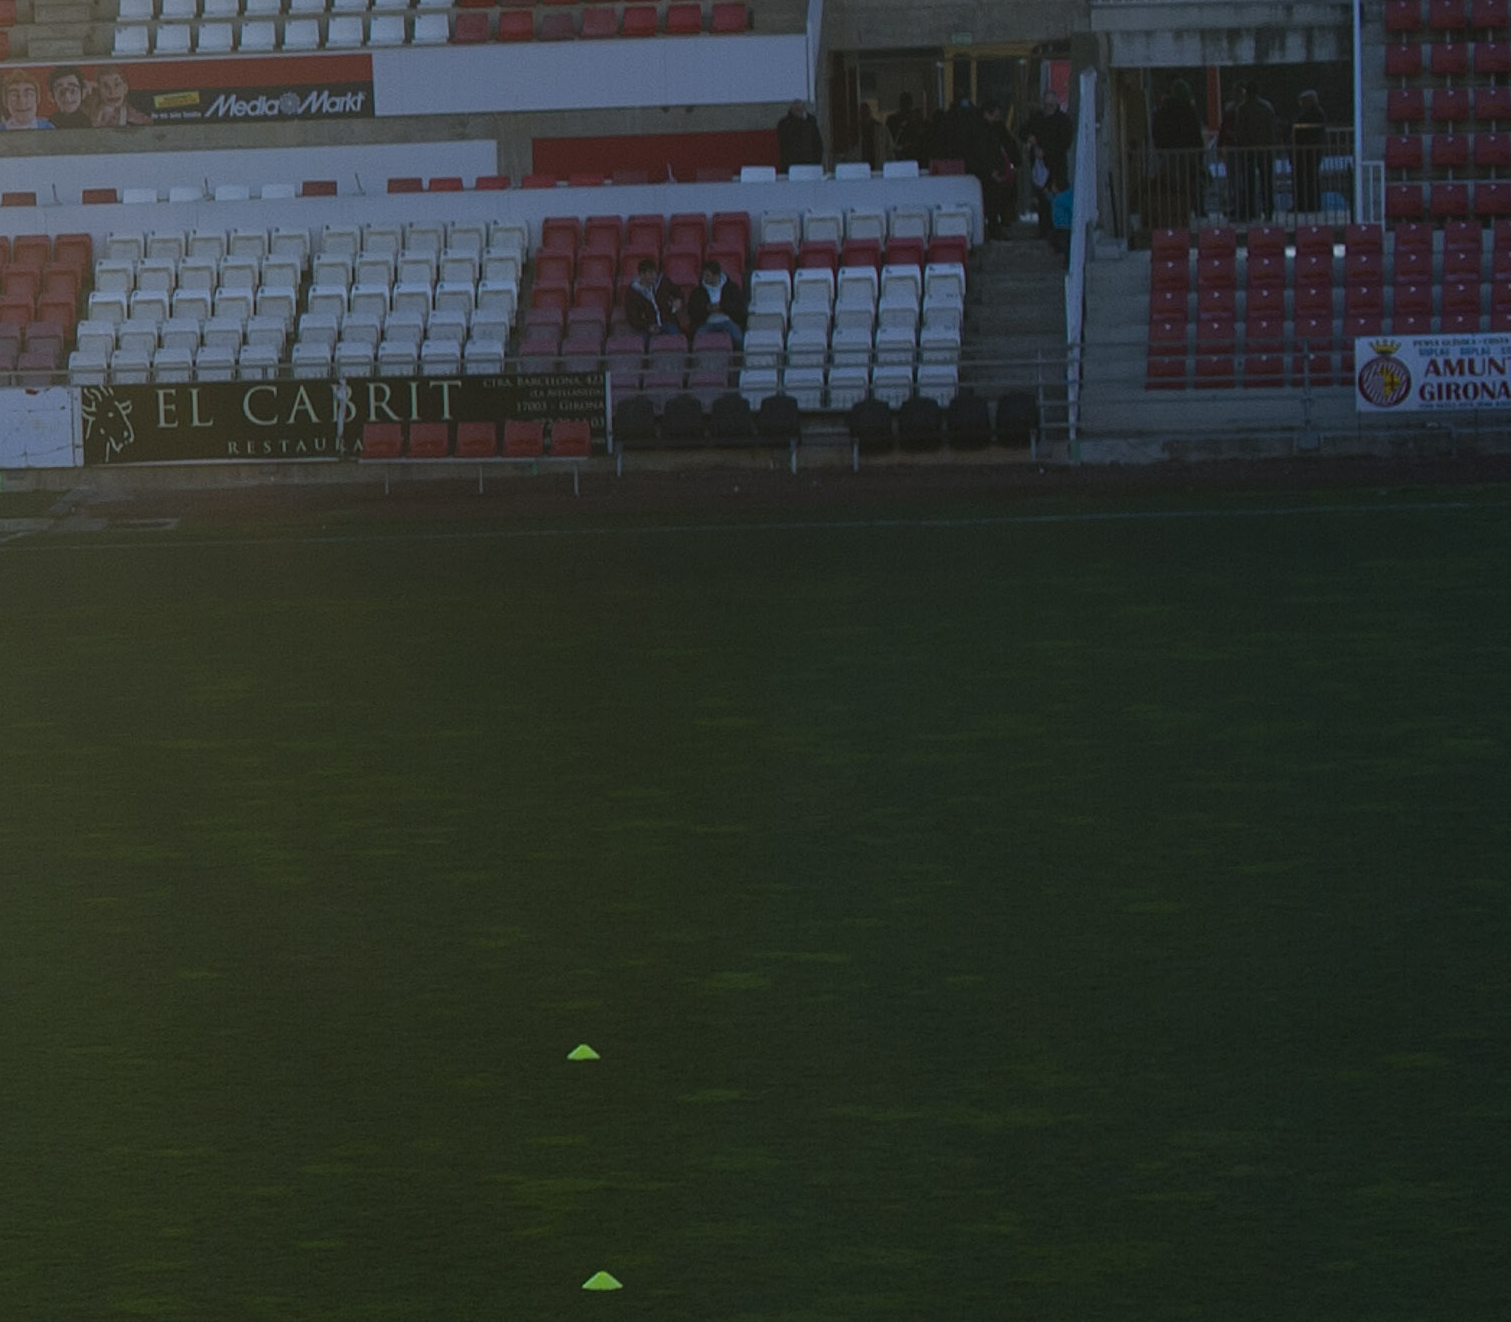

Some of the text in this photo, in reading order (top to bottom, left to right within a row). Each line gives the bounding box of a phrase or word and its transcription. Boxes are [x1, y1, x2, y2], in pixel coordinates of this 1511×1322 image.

[205, 93, 280, 118] Media
[298, 89, 365, 115] Markt
[1424, 357, 1511, 377] AMUN
[156, 379, 462, 428] EL CABRIT
[1419, 380, 1511, 402] GIRONA
